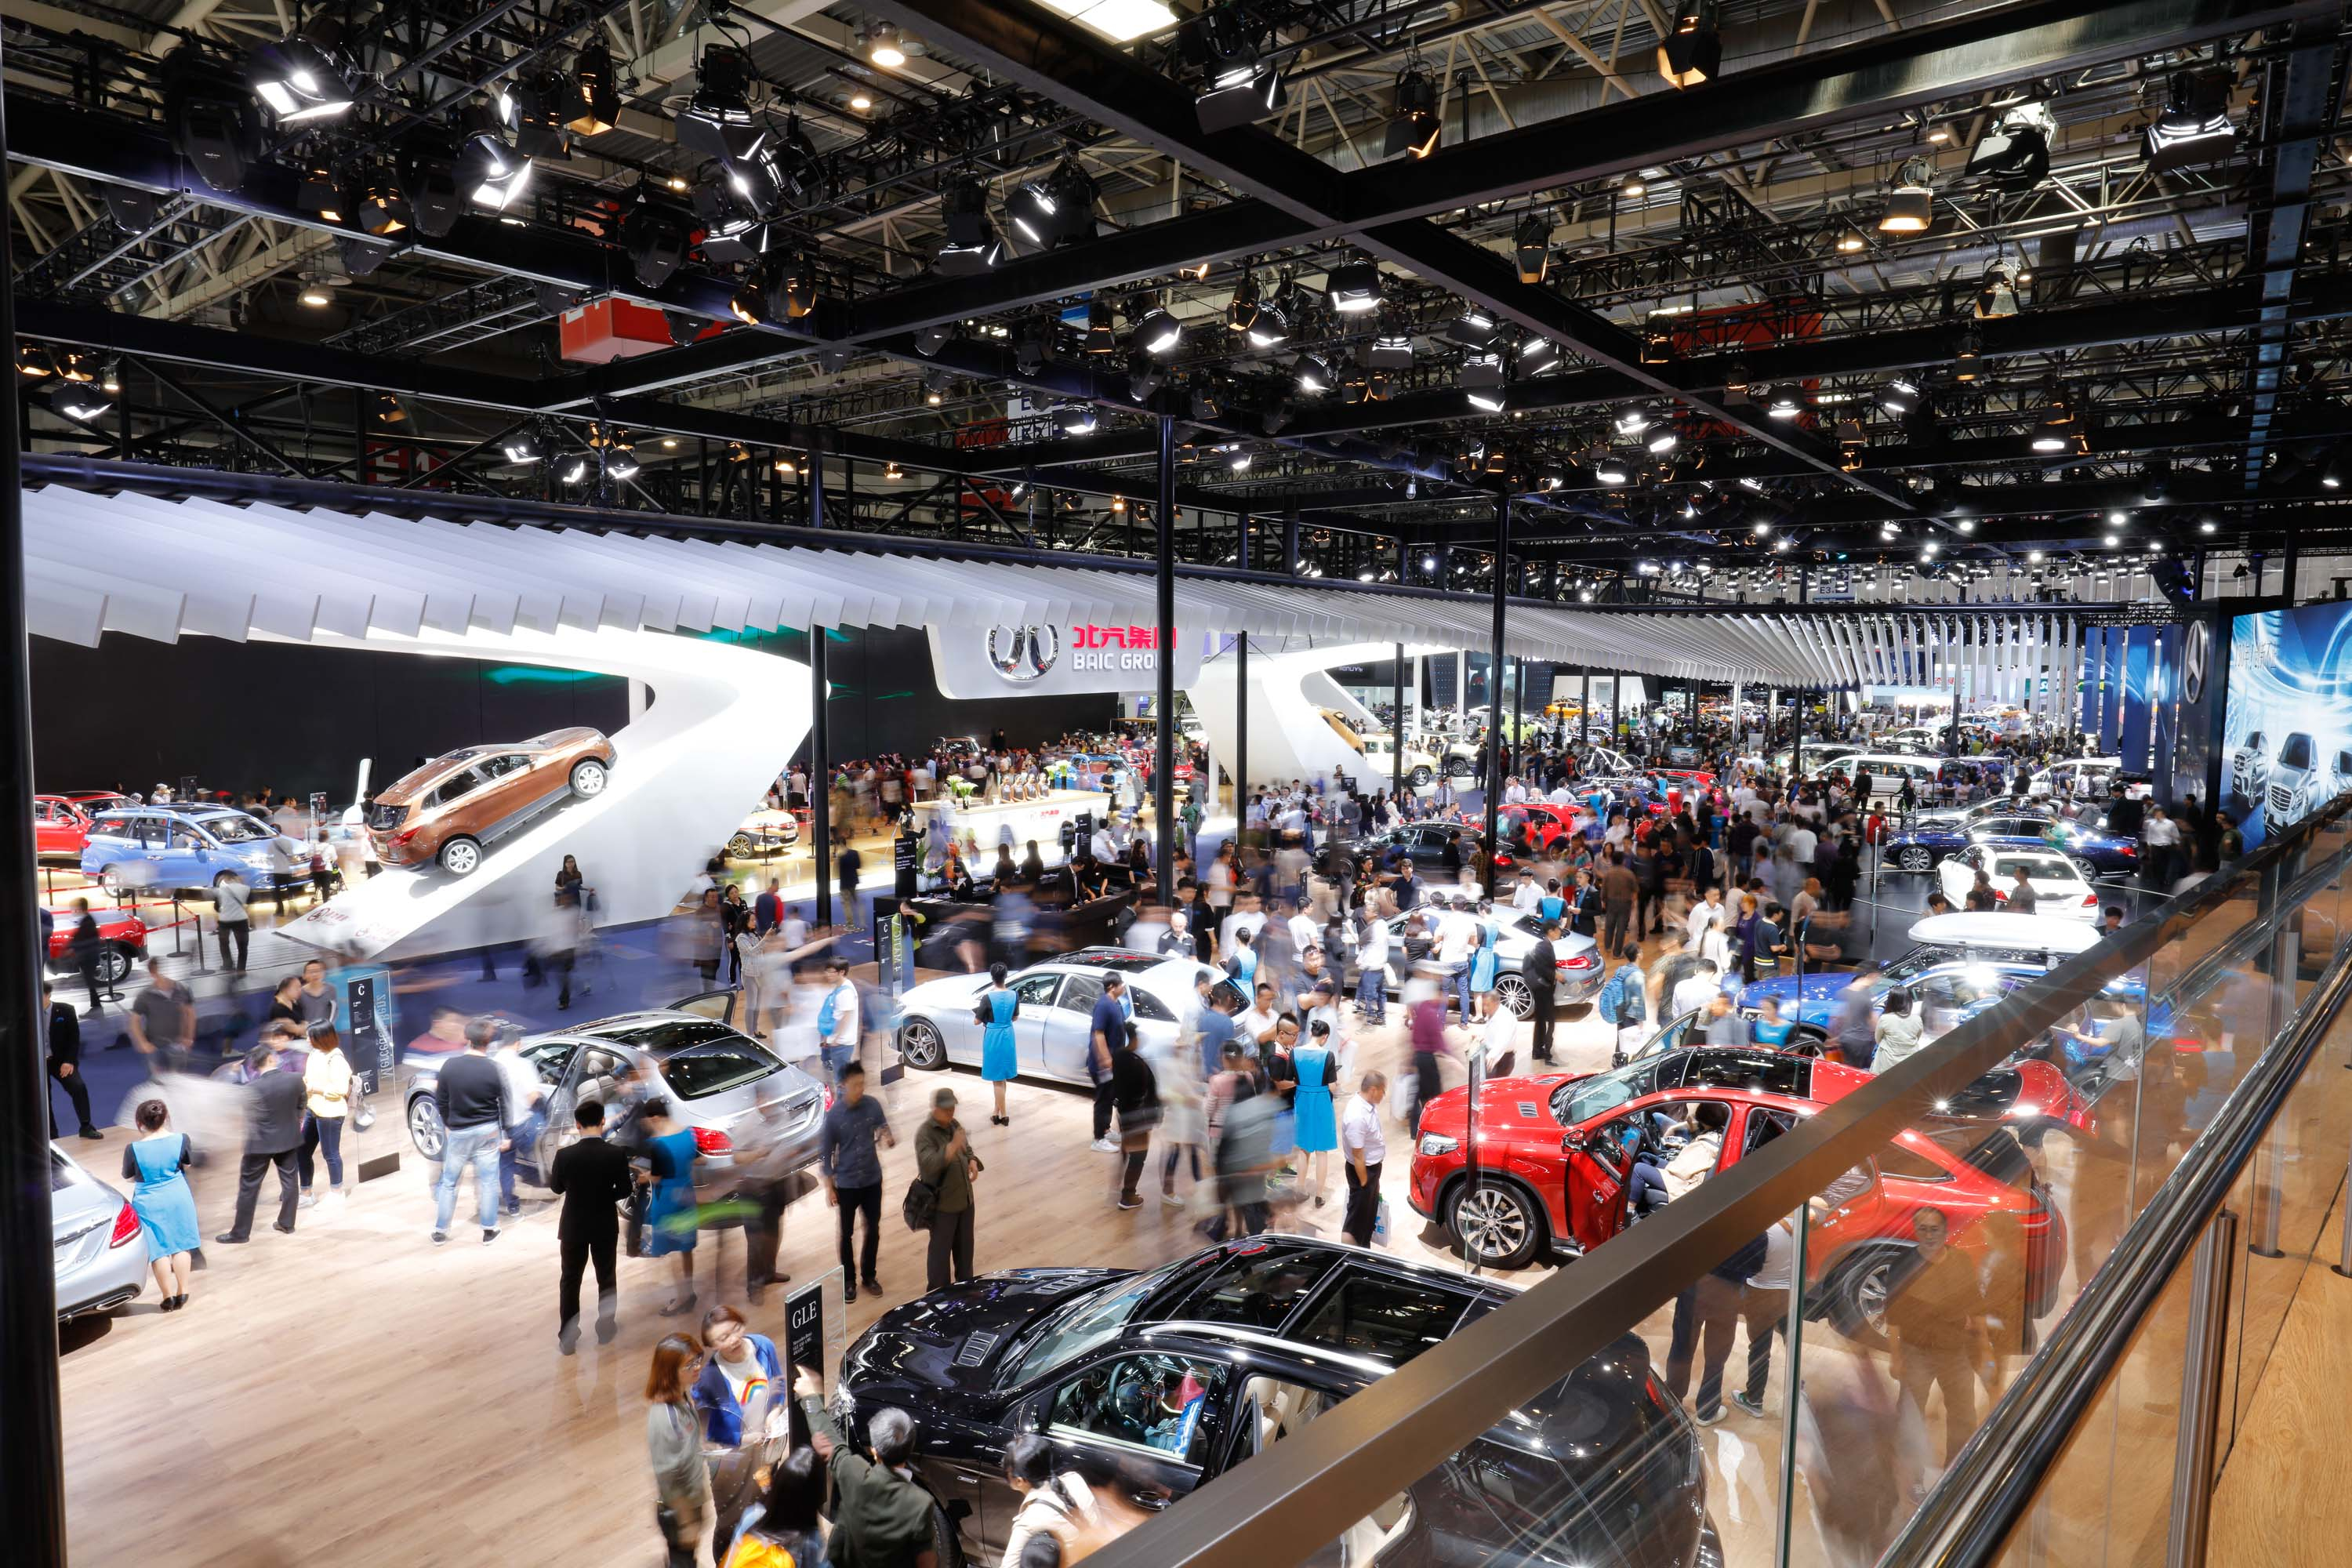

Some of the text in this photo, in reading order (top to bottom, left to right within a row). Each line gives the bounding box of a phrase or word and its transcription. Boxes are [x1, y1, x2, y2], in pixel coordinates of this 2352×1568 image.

[1073, 653, 1175, 670] BAIC GRO
[358, 985, 365, 996] C
[792, 1301, 817, 1329] GLE
